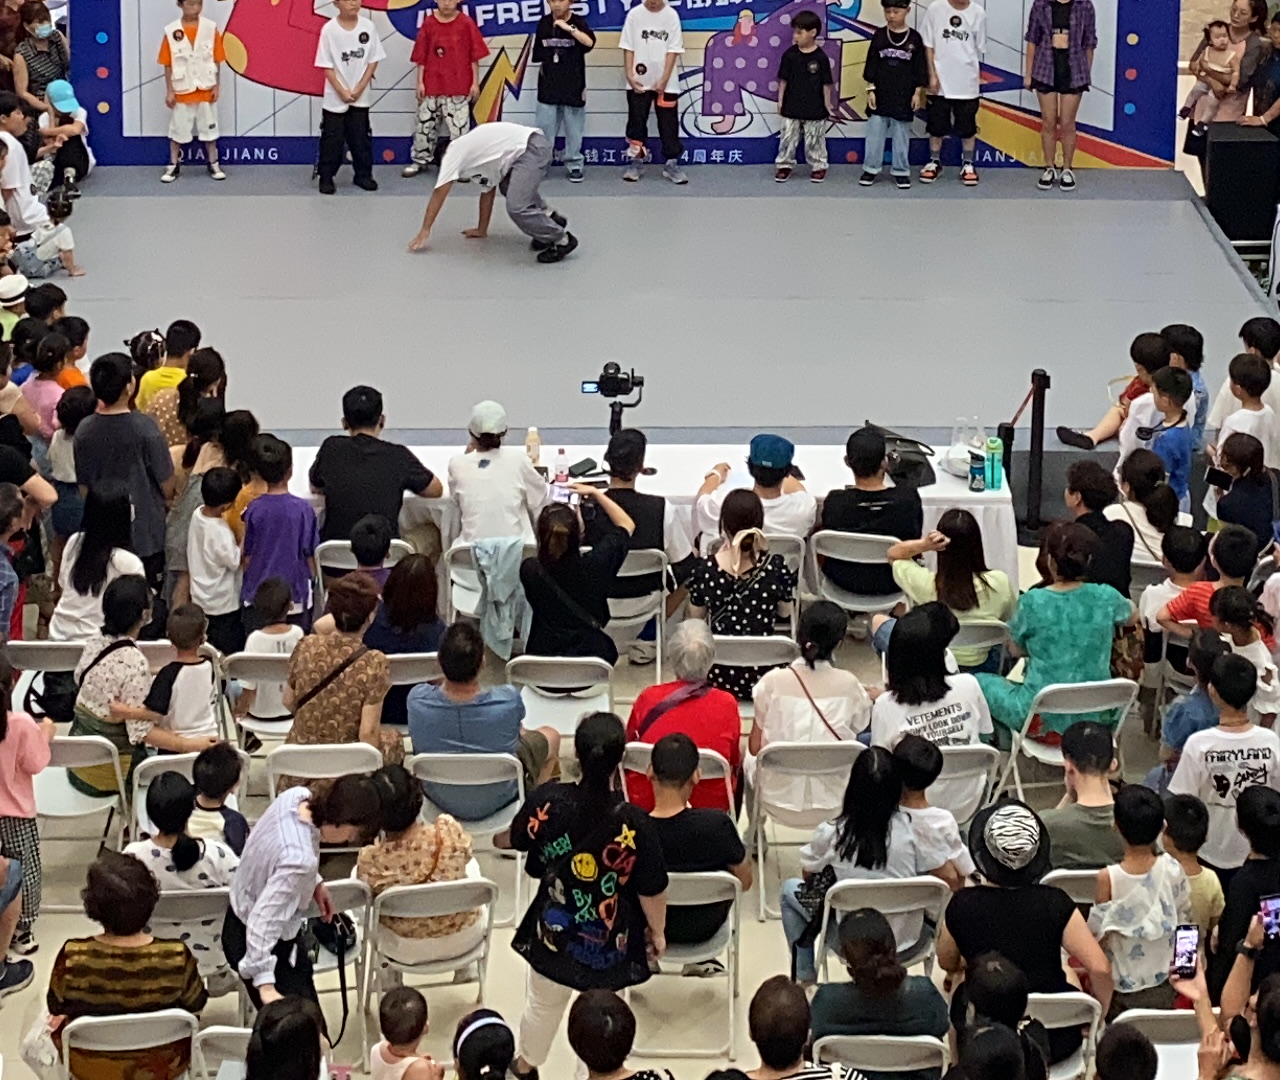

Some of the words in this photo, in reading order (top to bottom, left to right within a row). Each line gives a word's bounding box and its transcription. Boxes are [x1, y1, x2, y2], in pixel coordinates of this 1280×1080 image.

[177, 147, 279, 162] QIAJIANG
[680, 149, 744, 164] 4周年庆
[961, 150, 1065, 163] IANJIAG
[905, 702, 963, 726] VETEMENTS
